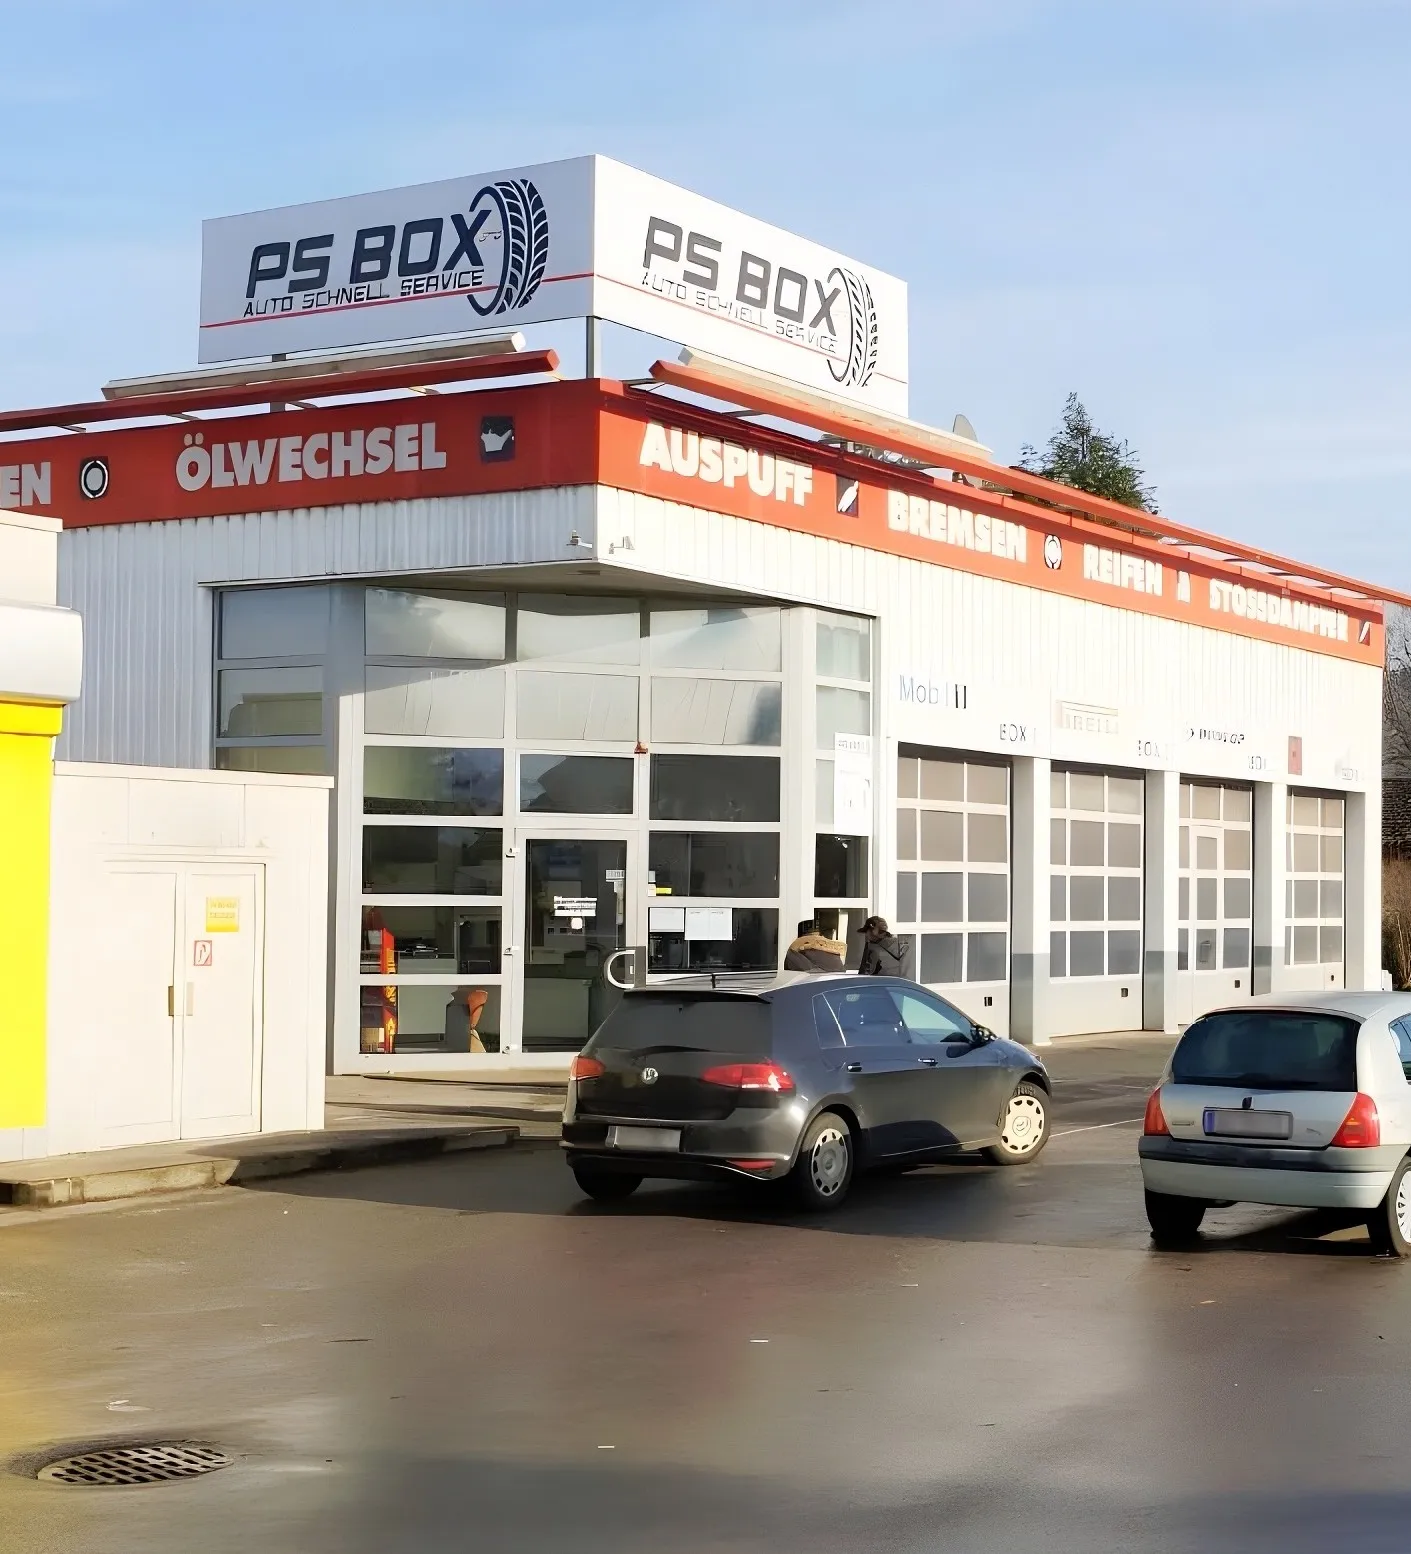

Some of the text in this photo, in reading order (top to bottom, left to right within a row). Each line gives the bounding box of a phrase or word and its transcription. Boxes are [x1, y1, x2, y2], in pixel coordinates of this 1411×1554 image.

[246, 210, 492, 298] PS BOX
[642, 271, 687, 300] AUTO
[643, 216, 841, 336] PS BOX
[243, 269, 485, 318] AUTO SCHNELL SERVICE
[176, 422, 446, 491] ÖLWECHSEL
[640, 420, 812, 506] AUSPUFF
[887, 487, 1026, 563] BREMSEN
[1083, 543, 1163, 596] REIFEN
